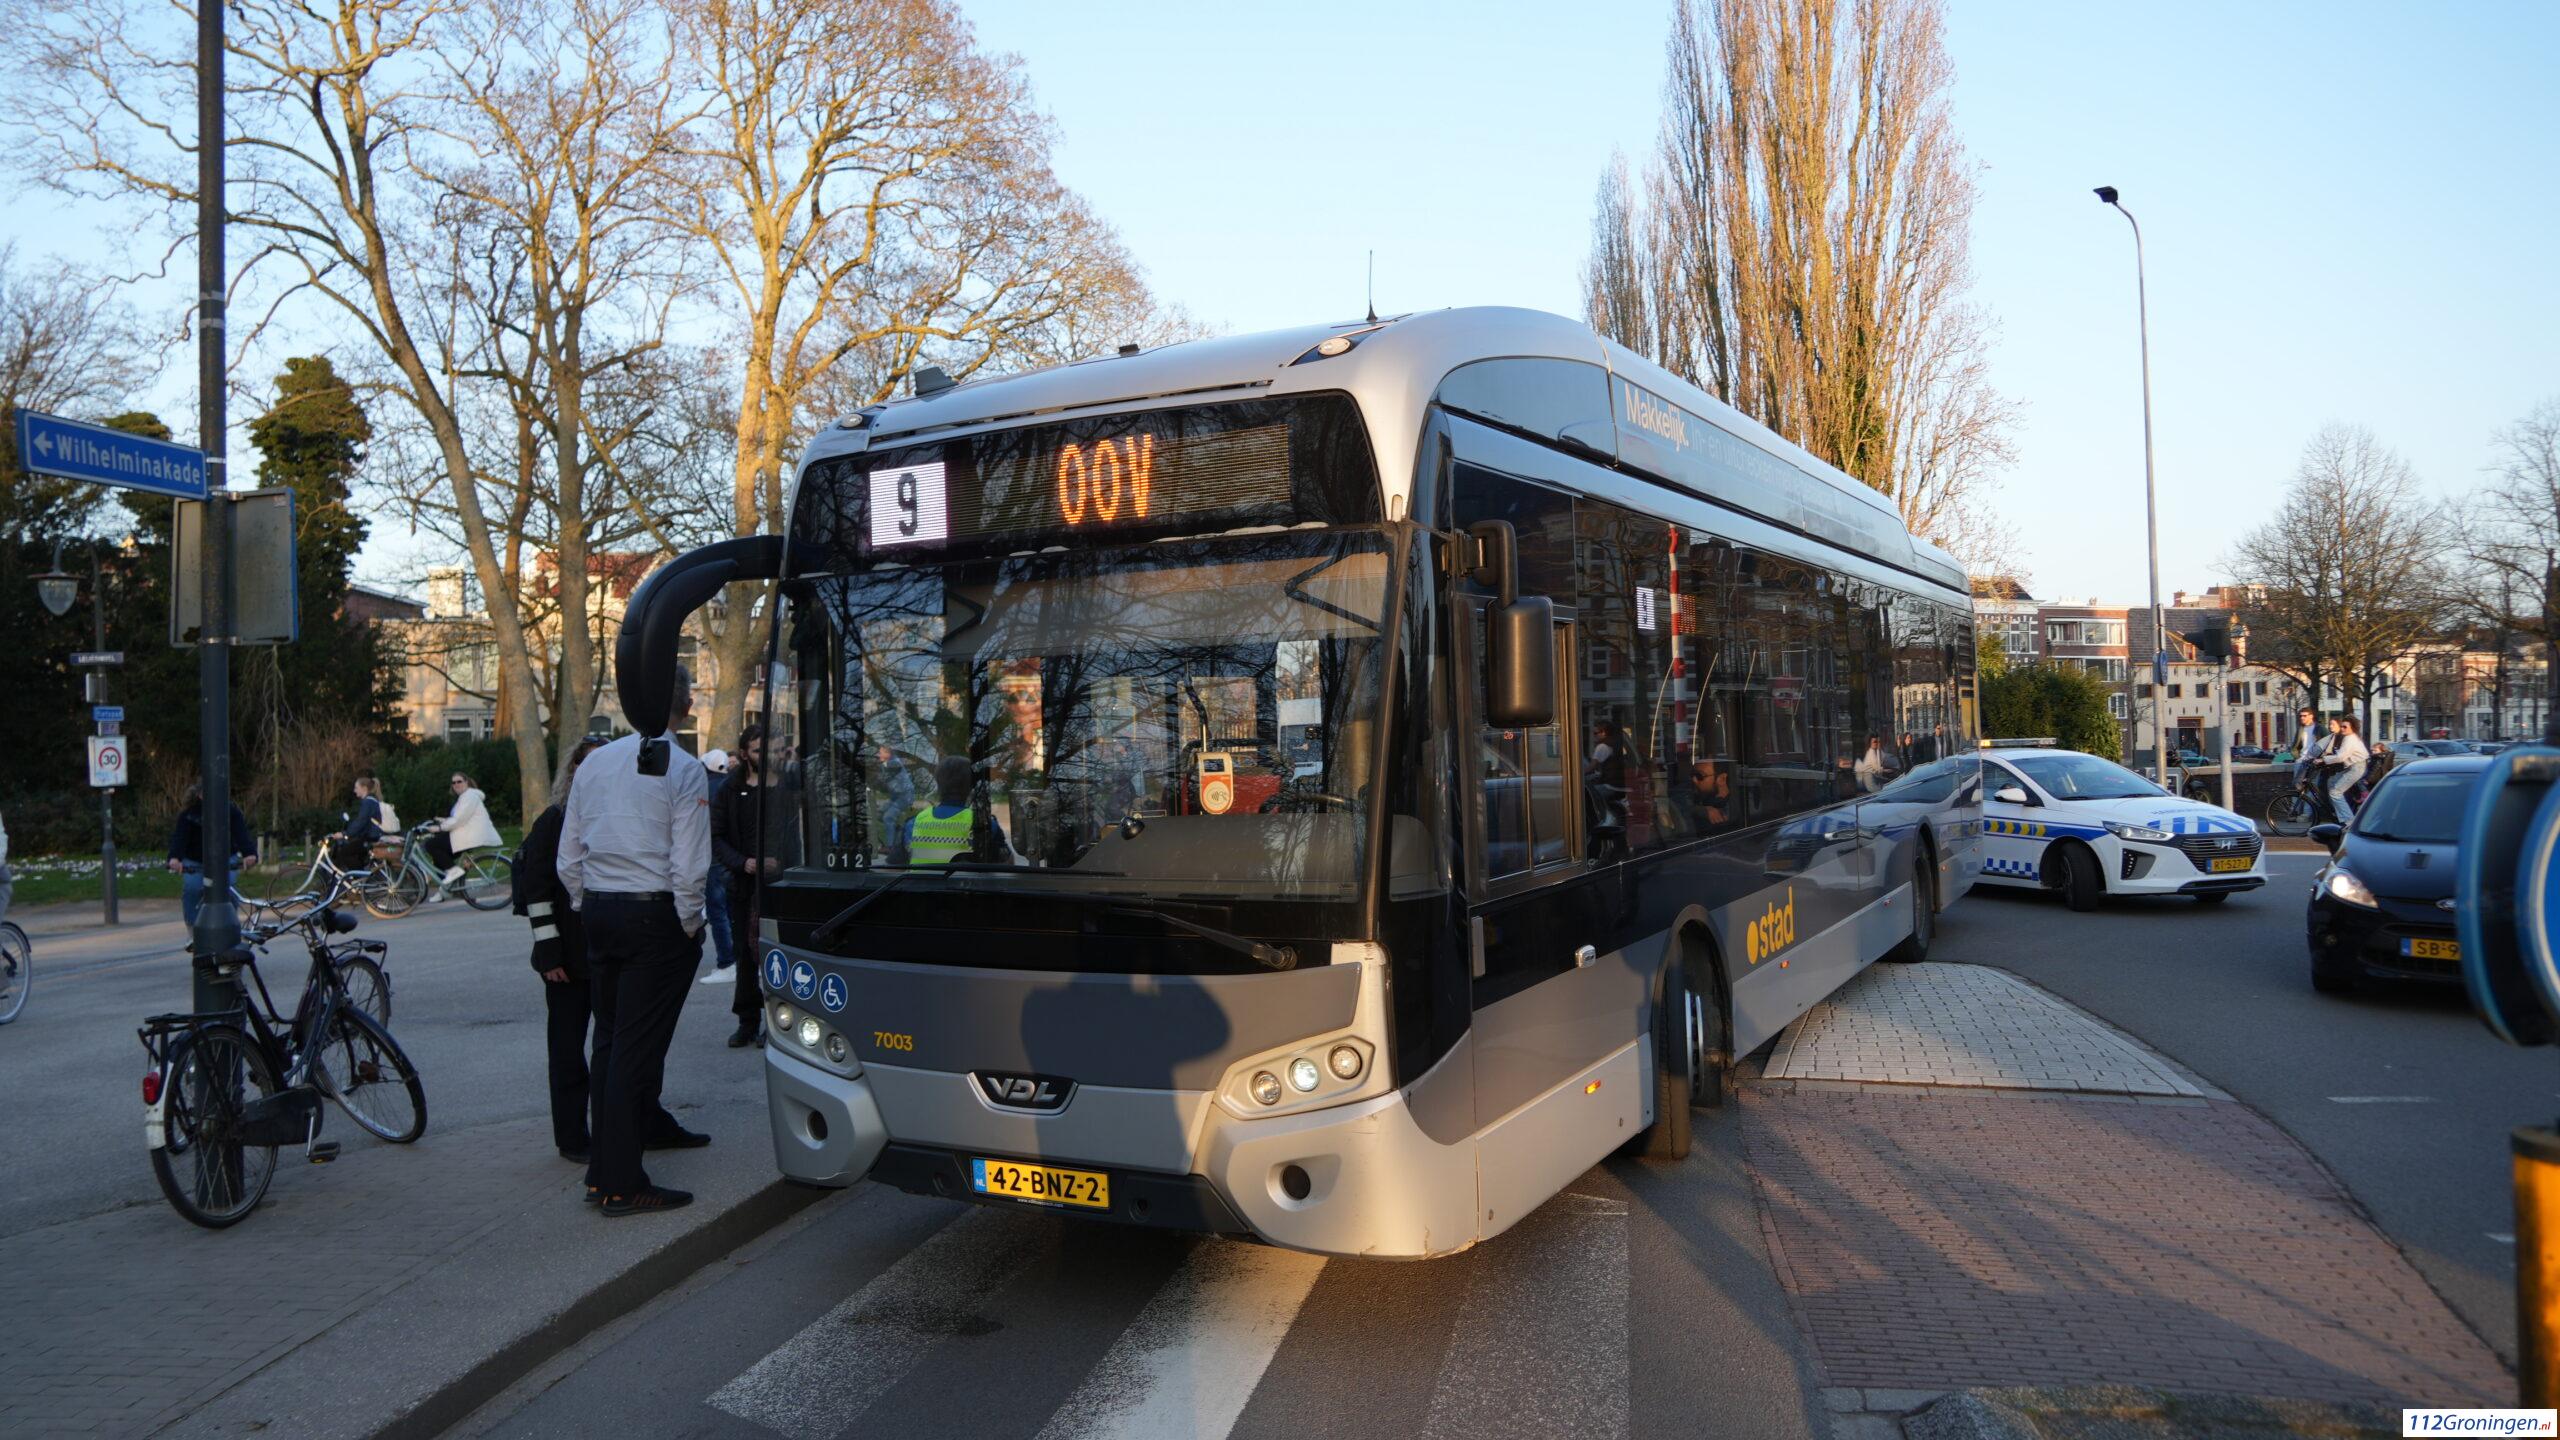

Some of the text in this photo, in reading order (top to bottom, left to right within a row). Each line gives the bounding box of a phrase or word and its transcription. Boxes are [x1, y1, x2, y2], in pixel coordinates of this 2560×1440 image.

[1624, 383, 1689, 452] Makkelijk.
[56, 433, 201, 485] Wilhelminakade
[897, 471, 918, 537] 9
[103, 754, 118, 765] 30
[1760, 885, 1794, 958] stad
[874, 1031, 913, 1052] 7003
[986, 1076, 1058, 1103] VDL
[975, 1166, 1101, 1202] NL 42-BNZ-2
